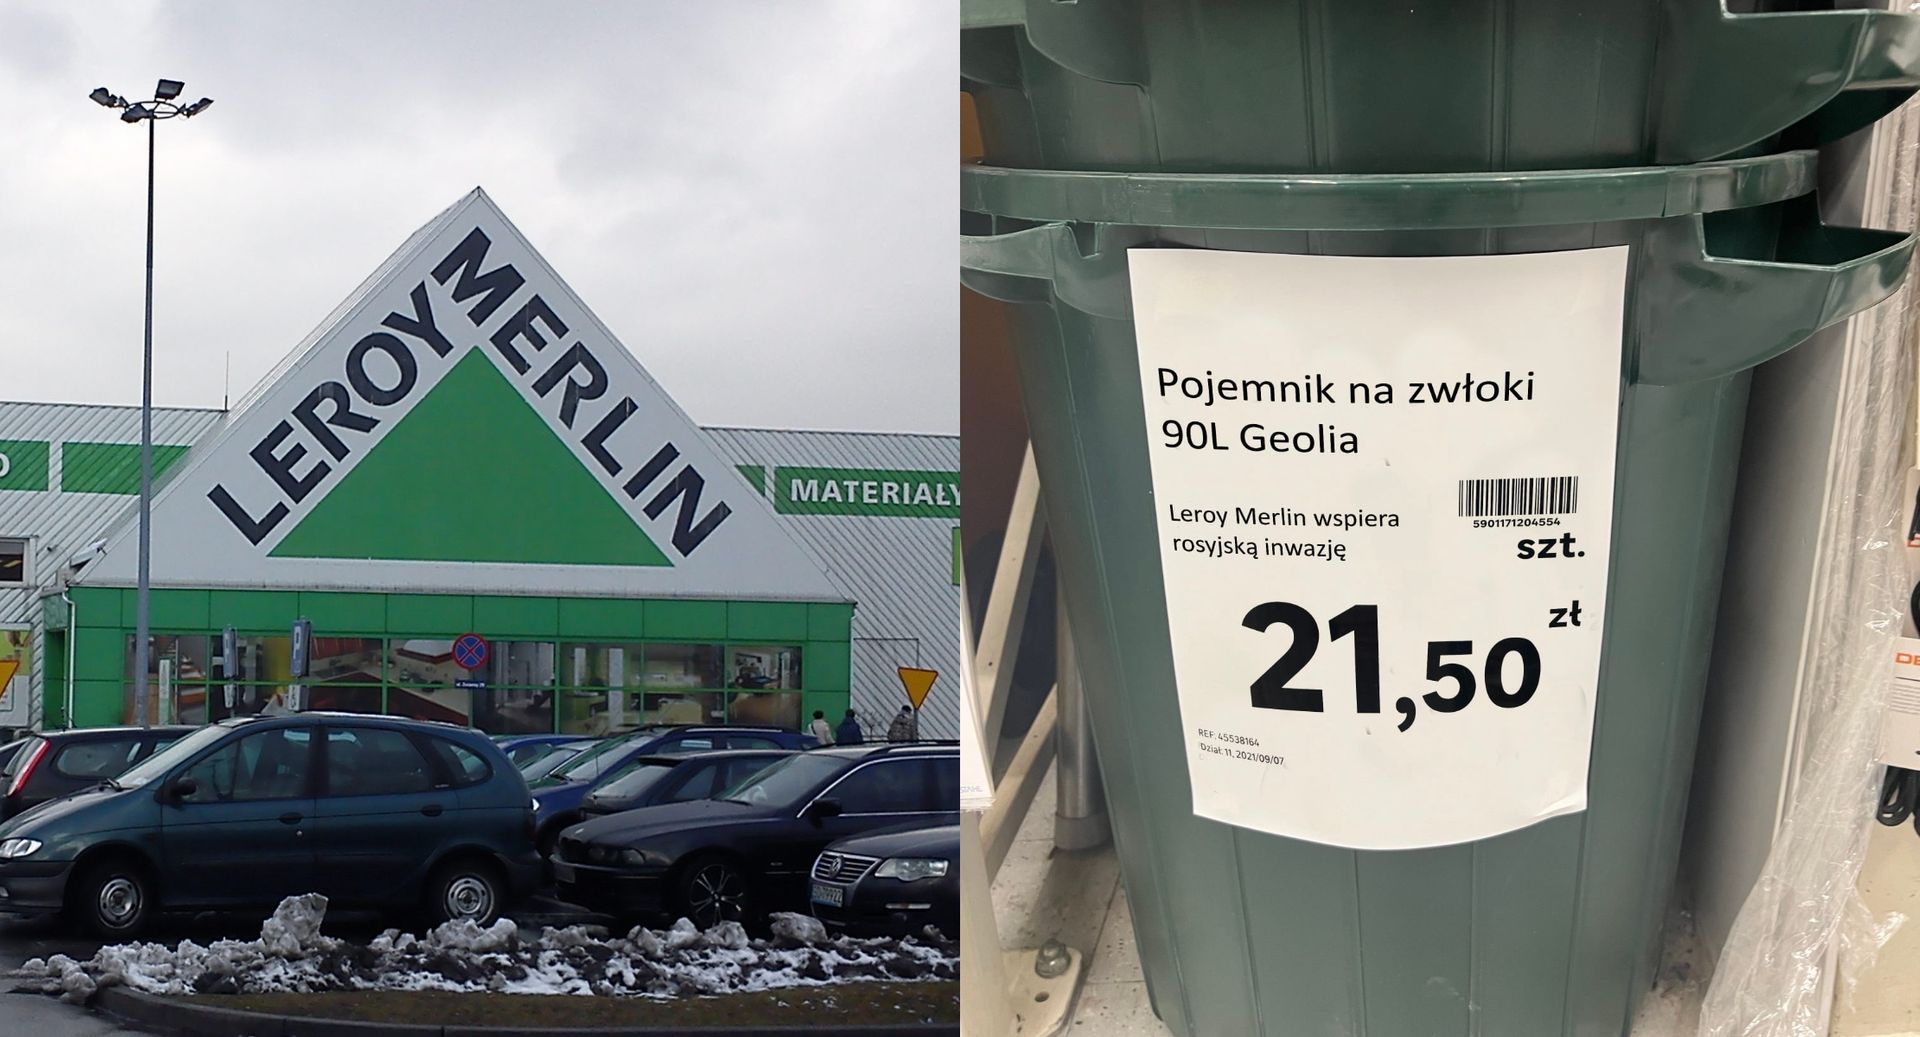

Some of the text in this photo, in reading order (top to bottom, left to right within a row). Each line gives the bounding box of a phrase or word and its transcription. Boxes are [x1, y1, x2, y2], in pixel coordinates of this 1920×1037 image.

[206, 226, 733, 558] LEROY MERLIN
[1157, 367, 1536, 407] Pojemnik na zwłoki
[1162, 419, 1359, 454] 90L Geolia
[1169, 504, 1400, 531] Leroy Merlin wspiera
[1473, 517, 1561, 528] 5901171204554
[1173, 536, 1347, 561] rosyjską inwazję
[1516, 532, 1586, 560] szt.
[1241, 599, 1582, 733] 21,50 zł
[1217, 733, 1260, 747] 45538164
[1235, 749, 1284, 765] 2021/09/07
